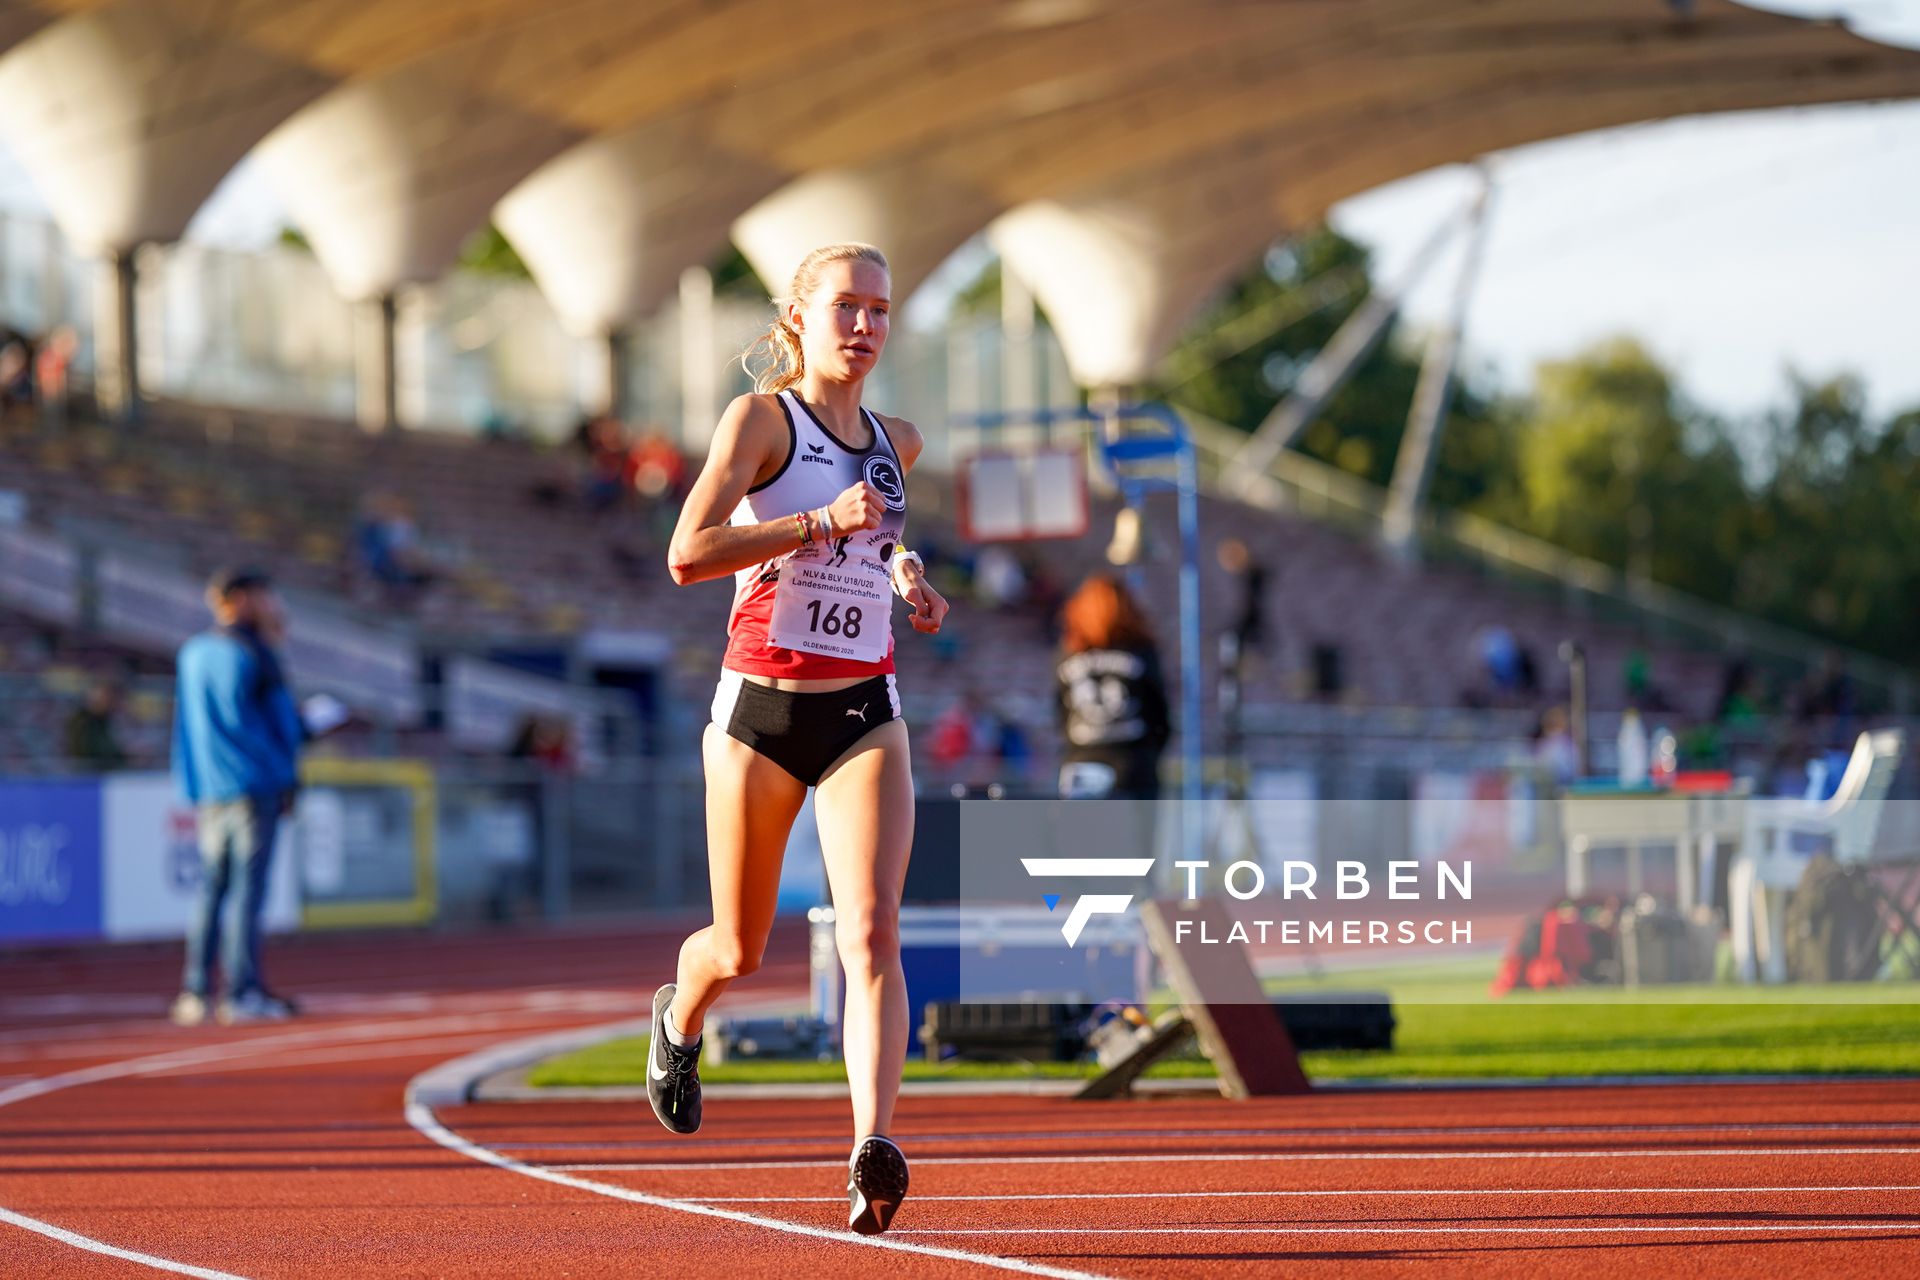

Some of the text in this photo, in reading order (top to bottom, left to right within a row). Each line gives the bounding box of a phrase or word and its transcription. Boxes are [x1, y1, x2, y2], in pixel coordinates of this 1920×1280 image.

[801, 455, 834, 466] erima
[792, 577, 881, 600] Landesmeisterschaften
[802, 569, 820, 579] NLV
[820, 572, 827, 580] &
[827, 573, 843, 582] BLV
[844, 576, 875, 589] U18/U20
[806, 599, 863, 639] 168
[802, 640, 855, 655] OLDENBURG 2020
